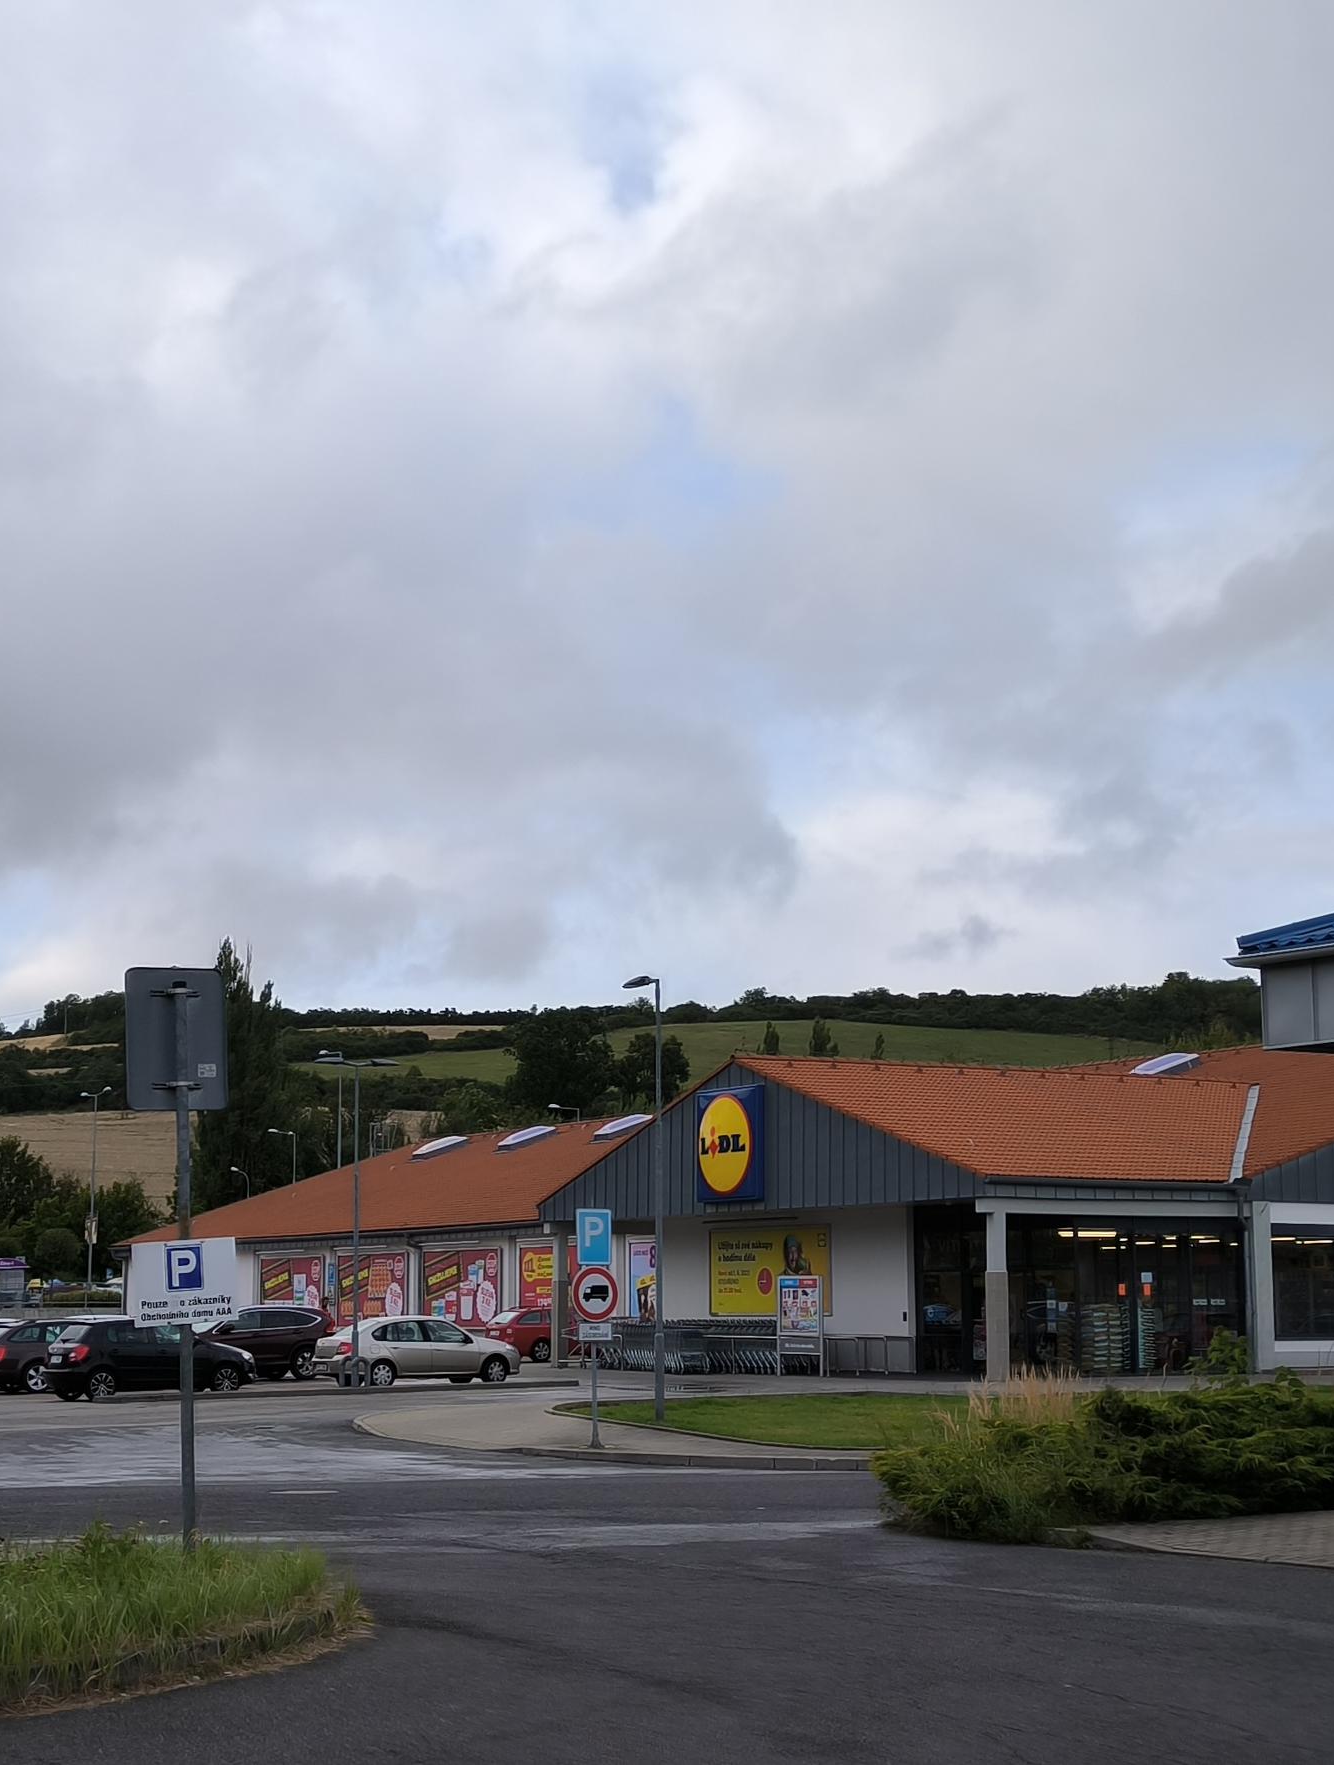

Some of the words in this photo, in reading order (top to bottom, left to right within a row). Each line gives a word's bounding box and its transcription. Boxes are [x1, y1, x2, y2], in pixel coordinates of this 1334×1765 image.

[584, 1216, 604, 1247] P
[171, 1250, 196, 1287] P
[141, 1301, 168, 1309] Pouze
[188, 1295, 231, 1306] zákazníky
[141, 1311, 189, 1321] Obchodního
[192, 1309, 213, 1318] domu
[216, 1307, 232, 1316] AAA
